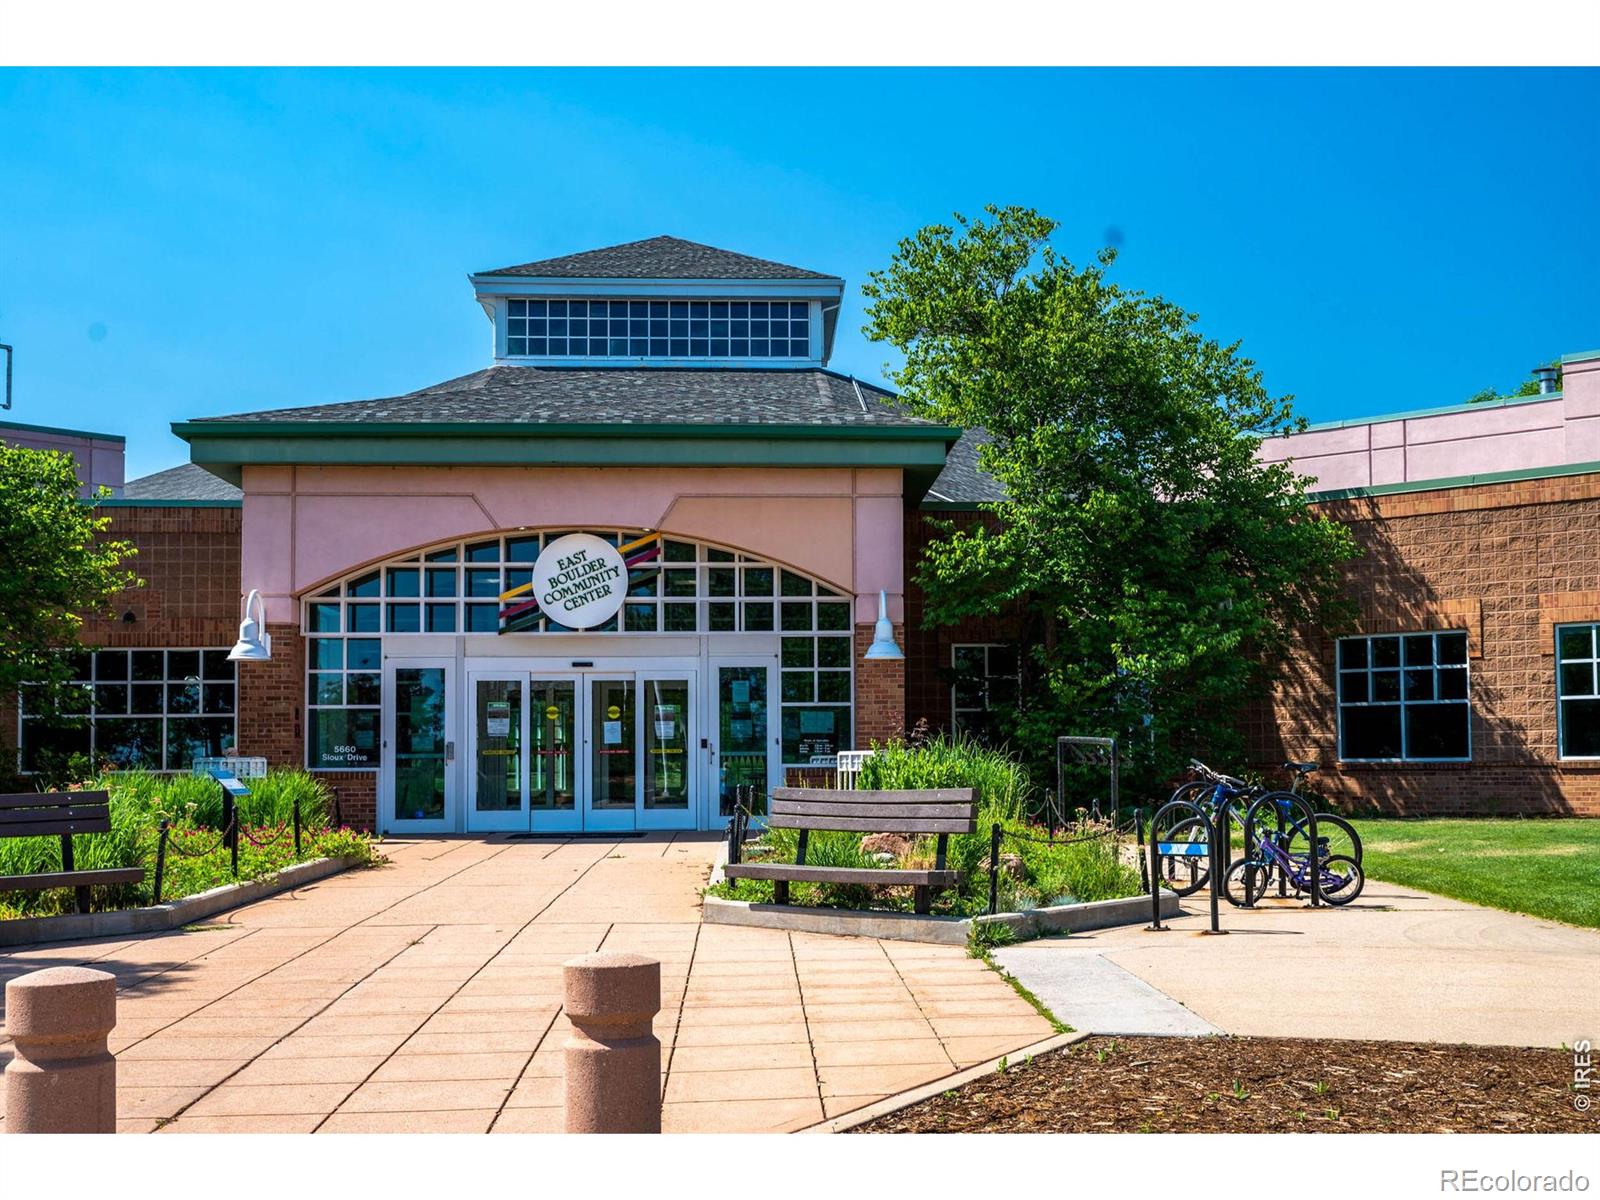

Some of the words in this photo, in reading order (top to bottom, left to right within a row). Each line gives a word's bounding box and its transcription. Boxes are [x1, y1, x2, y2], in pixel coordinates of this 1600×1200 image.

[557, 550, 587, 571] EAST
[548, 557, 607, 589] BOULDER
[543, 565, 621, 606] COMMUNITY
[563, 584, 613, 611] CENTER
[322, 753, 344, 761] Sioux
[347, 753, 368, 761] Drive
[334, 745, 356, 753] 5660
